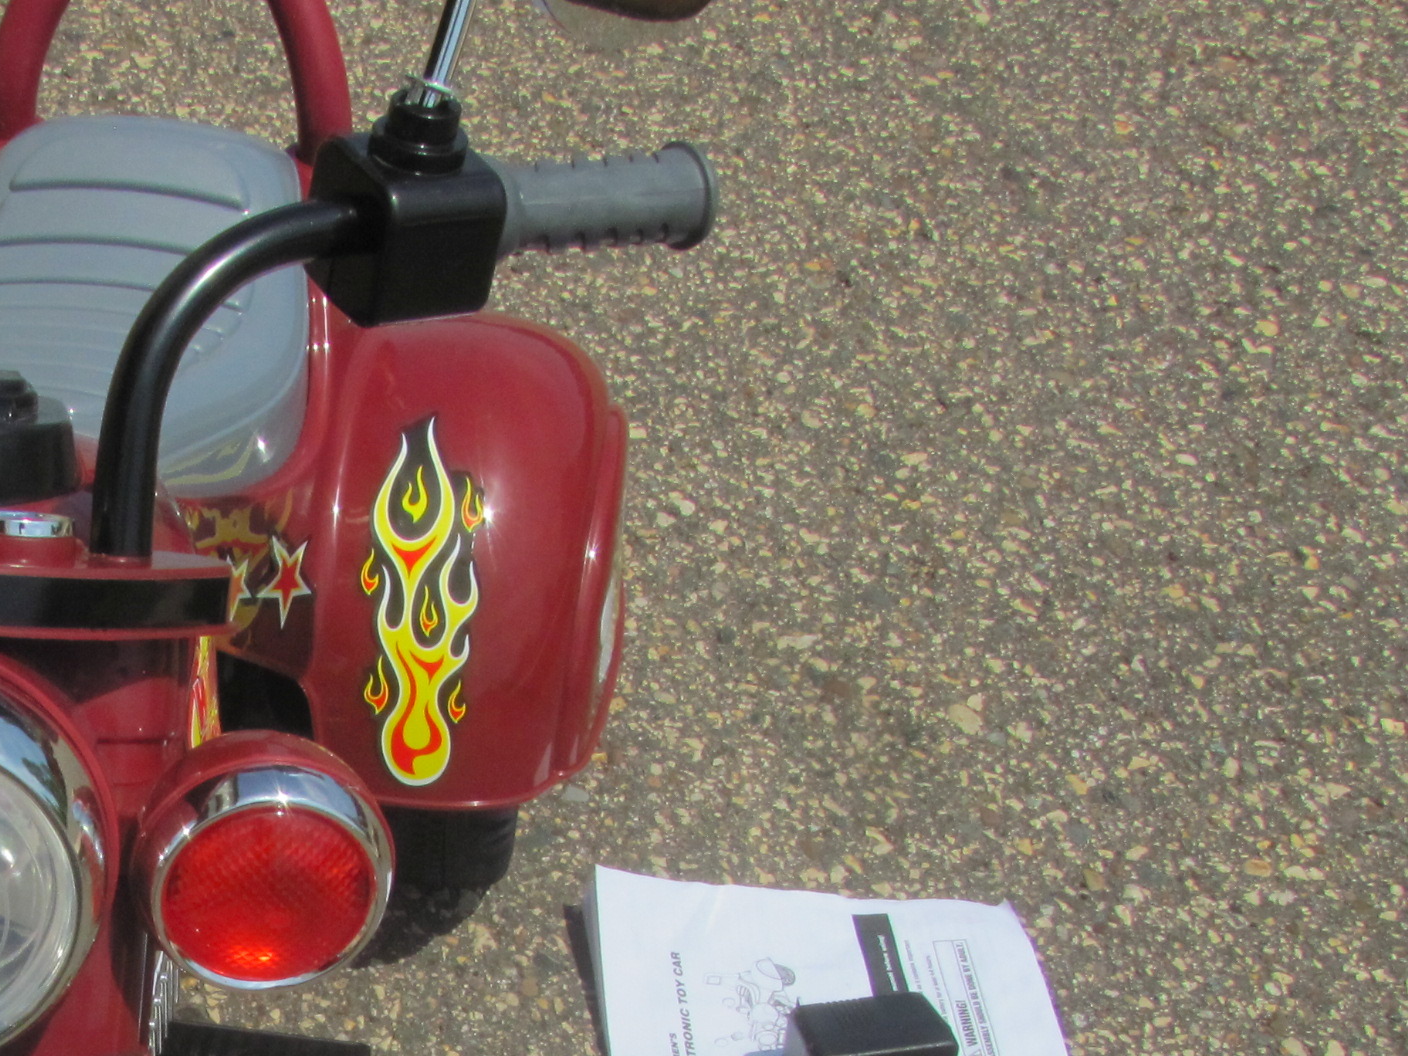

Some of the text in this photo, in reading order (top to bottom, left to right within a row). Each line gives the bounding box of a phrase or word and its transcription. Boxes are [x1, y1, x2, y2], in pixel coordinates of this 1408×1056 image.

[671, 951, 683, 976] CAR
[960, 964, 971, 973] BY
[675, 979, 688, 1004] TOY
[965, 974, 977, 991] DONE
[969, 992, 979, 1001] BE
[955, 1000, 978, 1047] WARNING!
[972, 1001, 987, 1024] SHOULD
